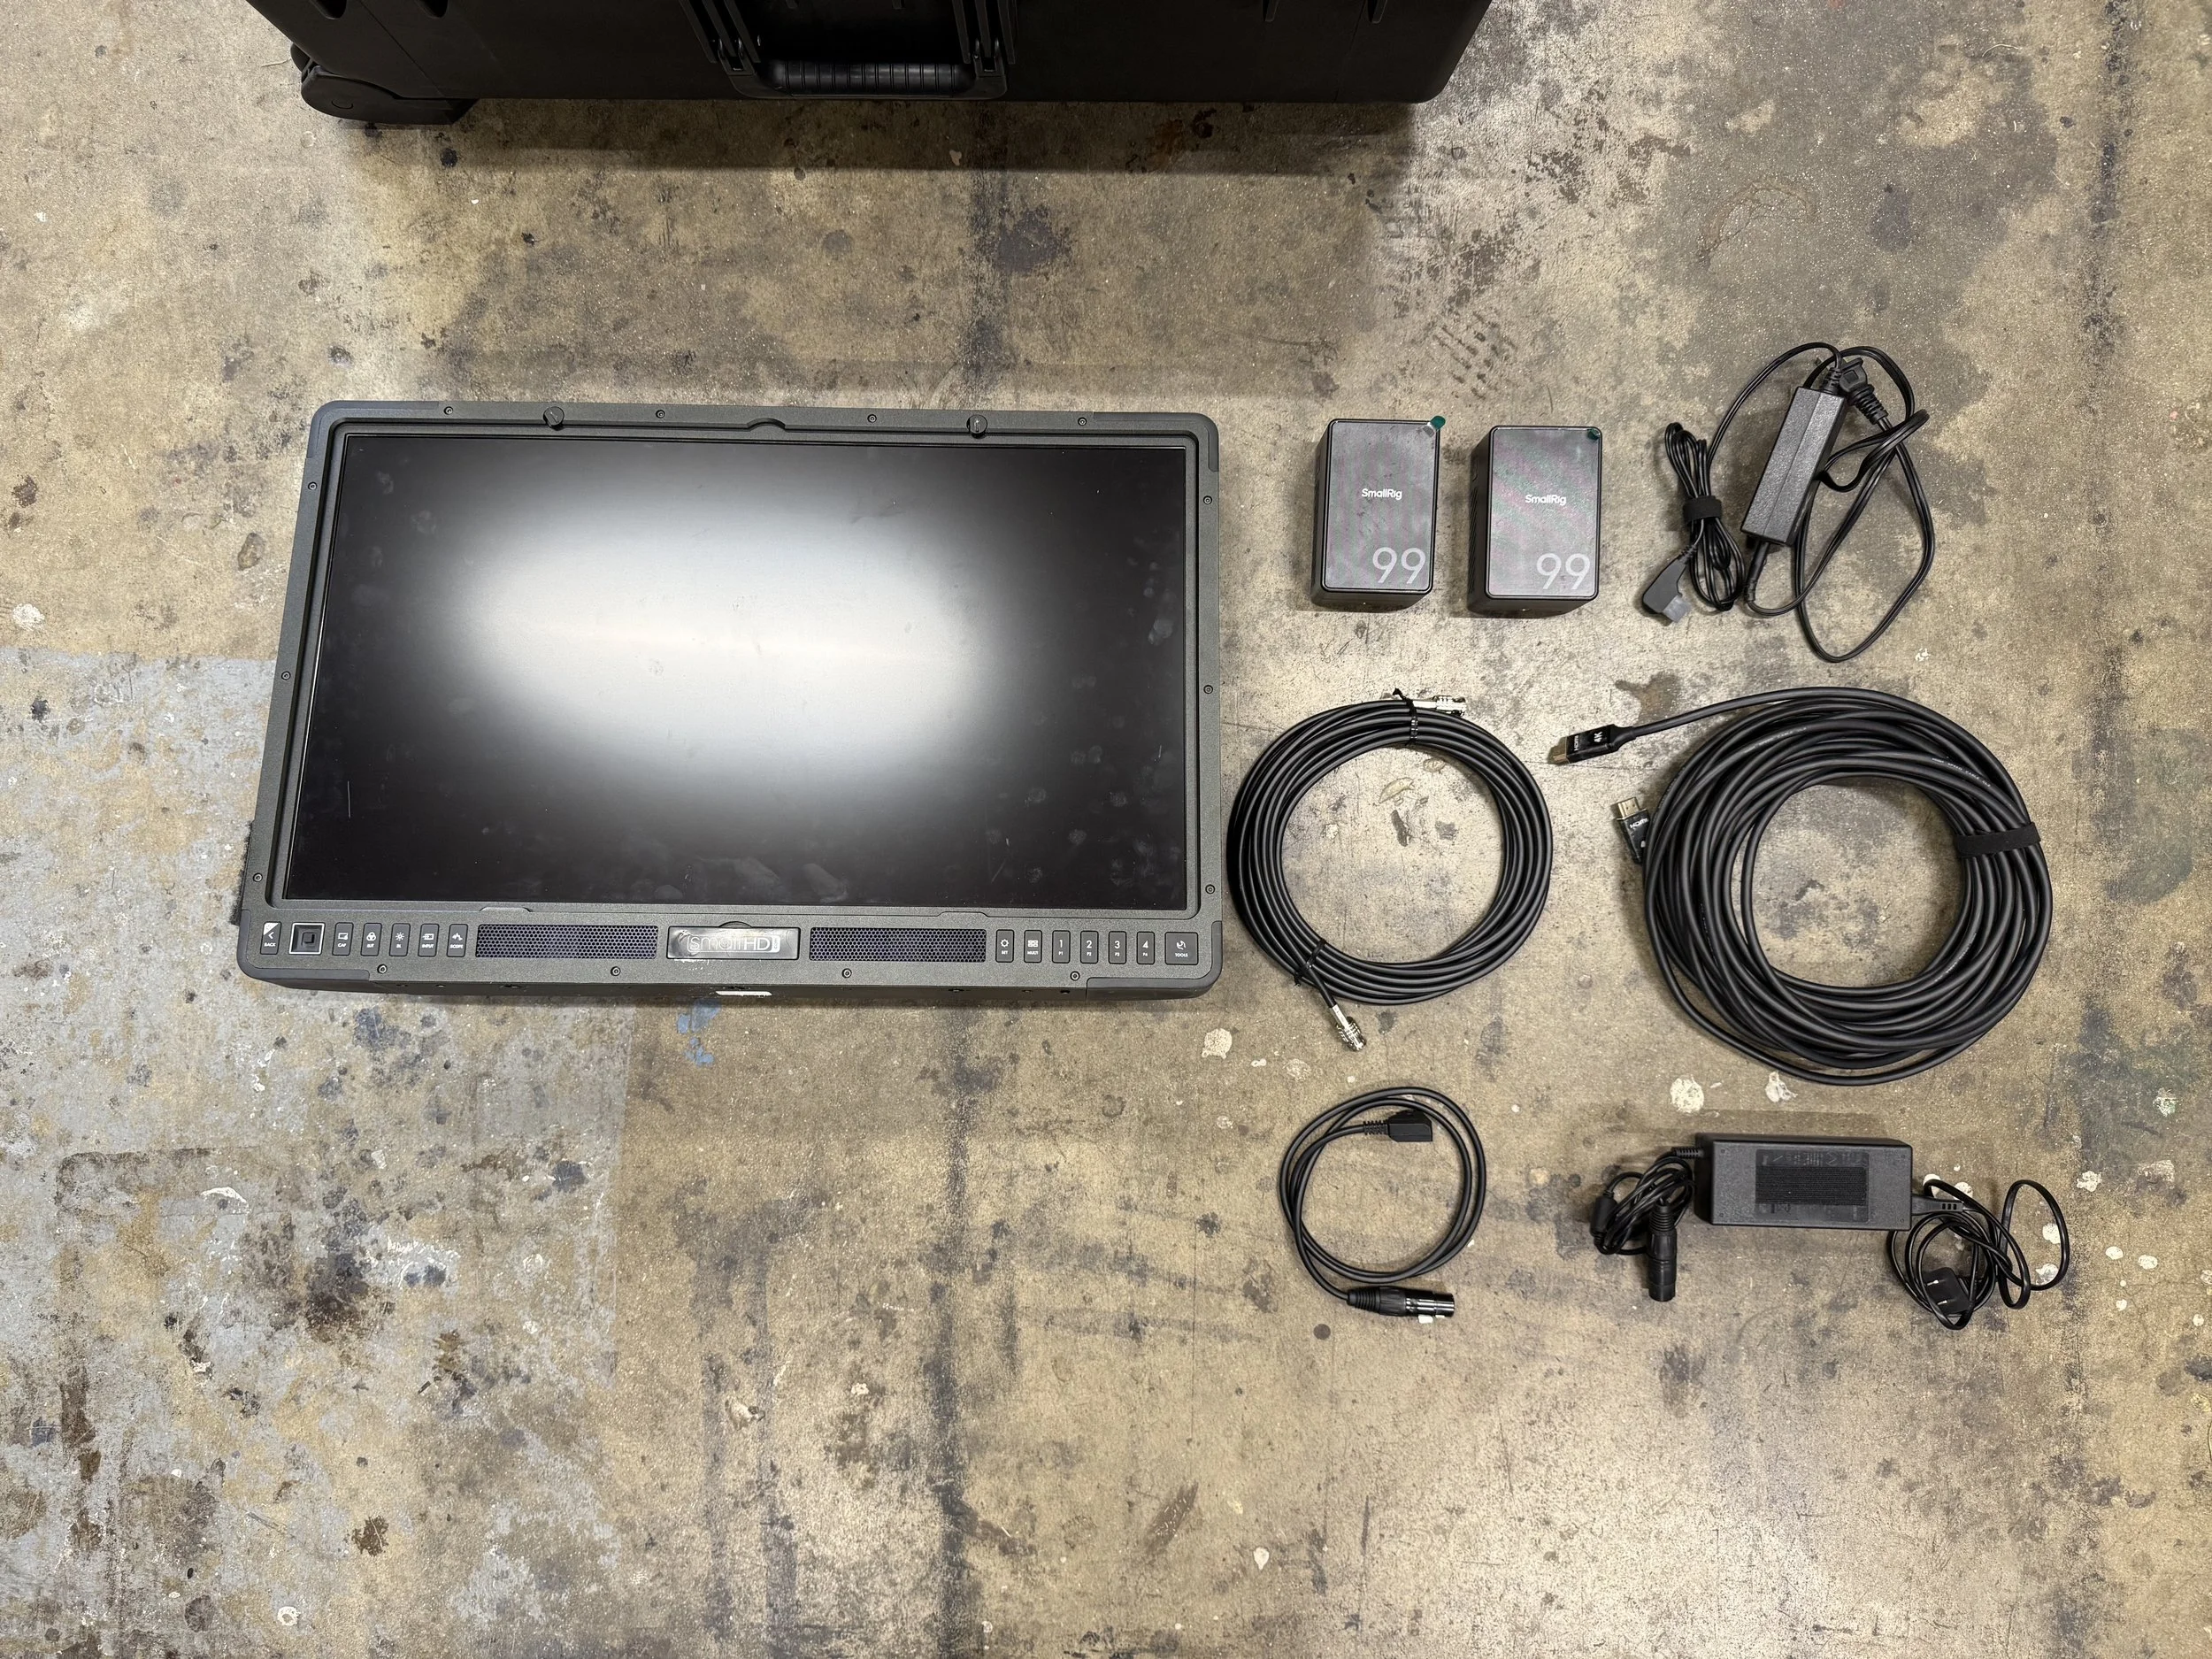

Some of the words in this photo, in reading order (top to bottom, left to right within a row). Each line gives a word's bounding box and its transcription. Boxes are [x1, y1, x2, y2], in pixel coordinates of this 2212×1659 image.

[1362, 488, 1402, 501] SmallRig
[1525, 495, 1567, 506] SmallRig
[1372, 547, 1425, 584] 99
[1537, 553, 1591, 589] 99
[1594, 731, 1602, 742] 4K
[1629, 818, 1648, 829] HDMI
[1059, 939, 1064, 949] 1
[1086, 940, 1093, 949] 2
[1114, 941, 1120, 949] 3
